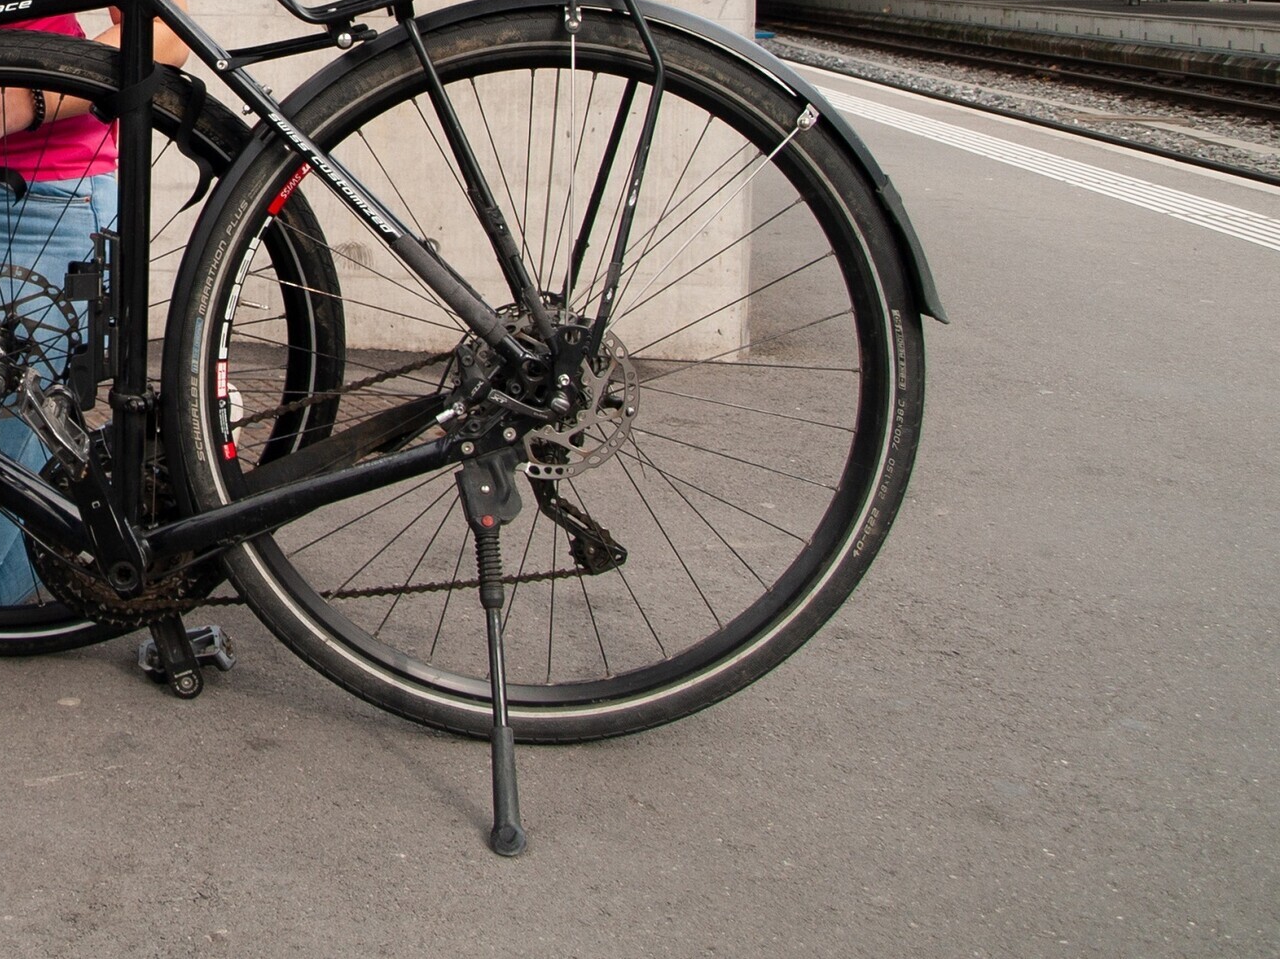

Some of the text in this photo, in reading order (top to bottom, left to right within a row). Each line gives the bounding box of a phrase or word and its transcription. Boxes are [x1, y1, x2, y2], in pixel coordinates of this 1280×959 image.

[280, 173, 302, 200] SWISS
[190, 376, 206, 462] SCHWALBE
[198, 239, 228, 316] MARATHON
[225, 199, 249, 237] PLUS
